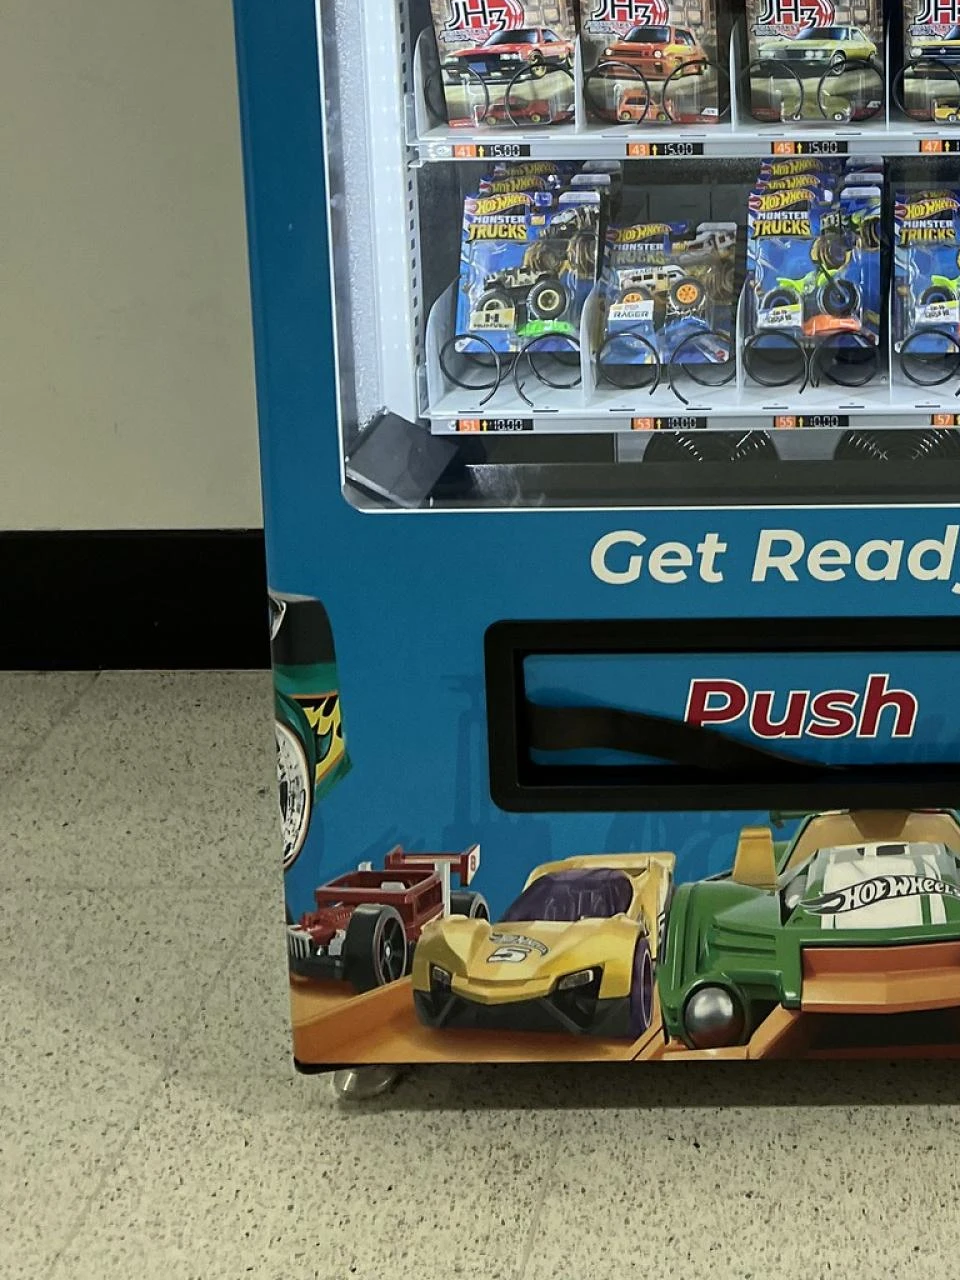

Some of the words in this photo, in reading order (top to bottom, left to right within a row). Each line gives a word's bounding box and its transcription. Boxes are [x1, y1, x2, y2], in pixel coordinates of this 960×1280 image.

[632, 145, 646, 155] 43
[778, 144, 791, 153] 45
[925, 141, 938, 151] 47
[459, 147, 473, 157] 41
[469, 224, 527, 240] TRUCKS
[753, 220, 811, 236] TRUCKS
[900, 229, 955, 244] TRUCKS
[463, 420, 477, 430] 51
[636, 419, 651, 428] 53
[779, 417, 793, 426] 55
[937, 415, 951, 425] 57
[590, 530, 727, 584] Get
[684, 674, 919, 739] Push
[487, 947, 527, 963] 5
